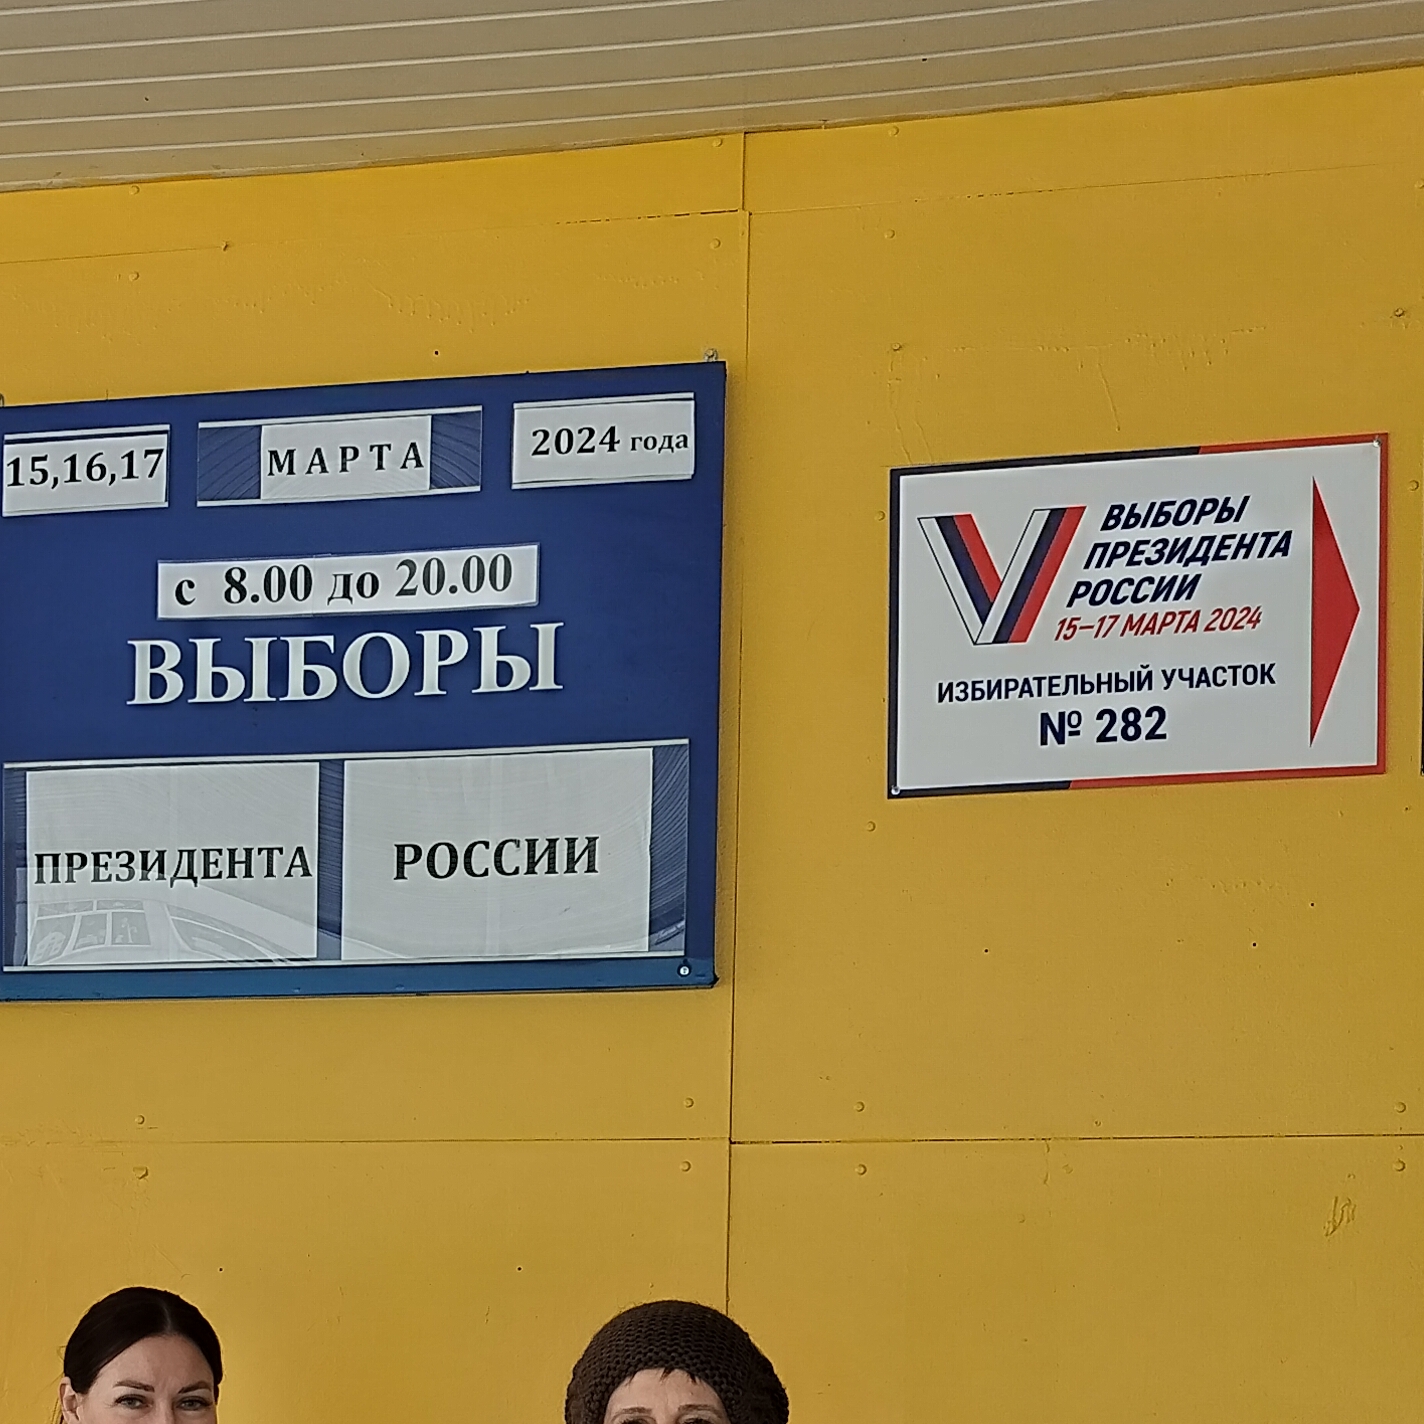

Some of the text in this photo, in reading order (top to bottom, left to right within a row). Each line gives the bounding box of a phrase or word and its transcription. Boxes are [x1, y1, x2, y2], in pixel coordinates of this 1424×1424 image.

[5, 447, 165, 490] 15,16,17
[530, 425, 622, 457] 2024
[629, 430, 690, 455] года
[1100, 495, 1251, 532] ВЫБОРЫ
[1083, 529, 1293, 570] ПРЕЗИДЕНТА
[175, 553, 513, 605] с 8.00 до 20.00
[1066, 573, 1202, 608] РОССИИ
[1120, 610, 1200, 638] МАРТА
[1204, 605, 1262, 633] 2024
[126, 621, 564, 705] ВЫБОРЫ
[937, 662, 1276, 704] ИЗБИРАТЕЛЬНЫЙ УЧАСТОК
[1039, 705, 1168, 746] № 282
[33, 836, 600, 888] ПРЕЗИДЕНТА РОССИИ
